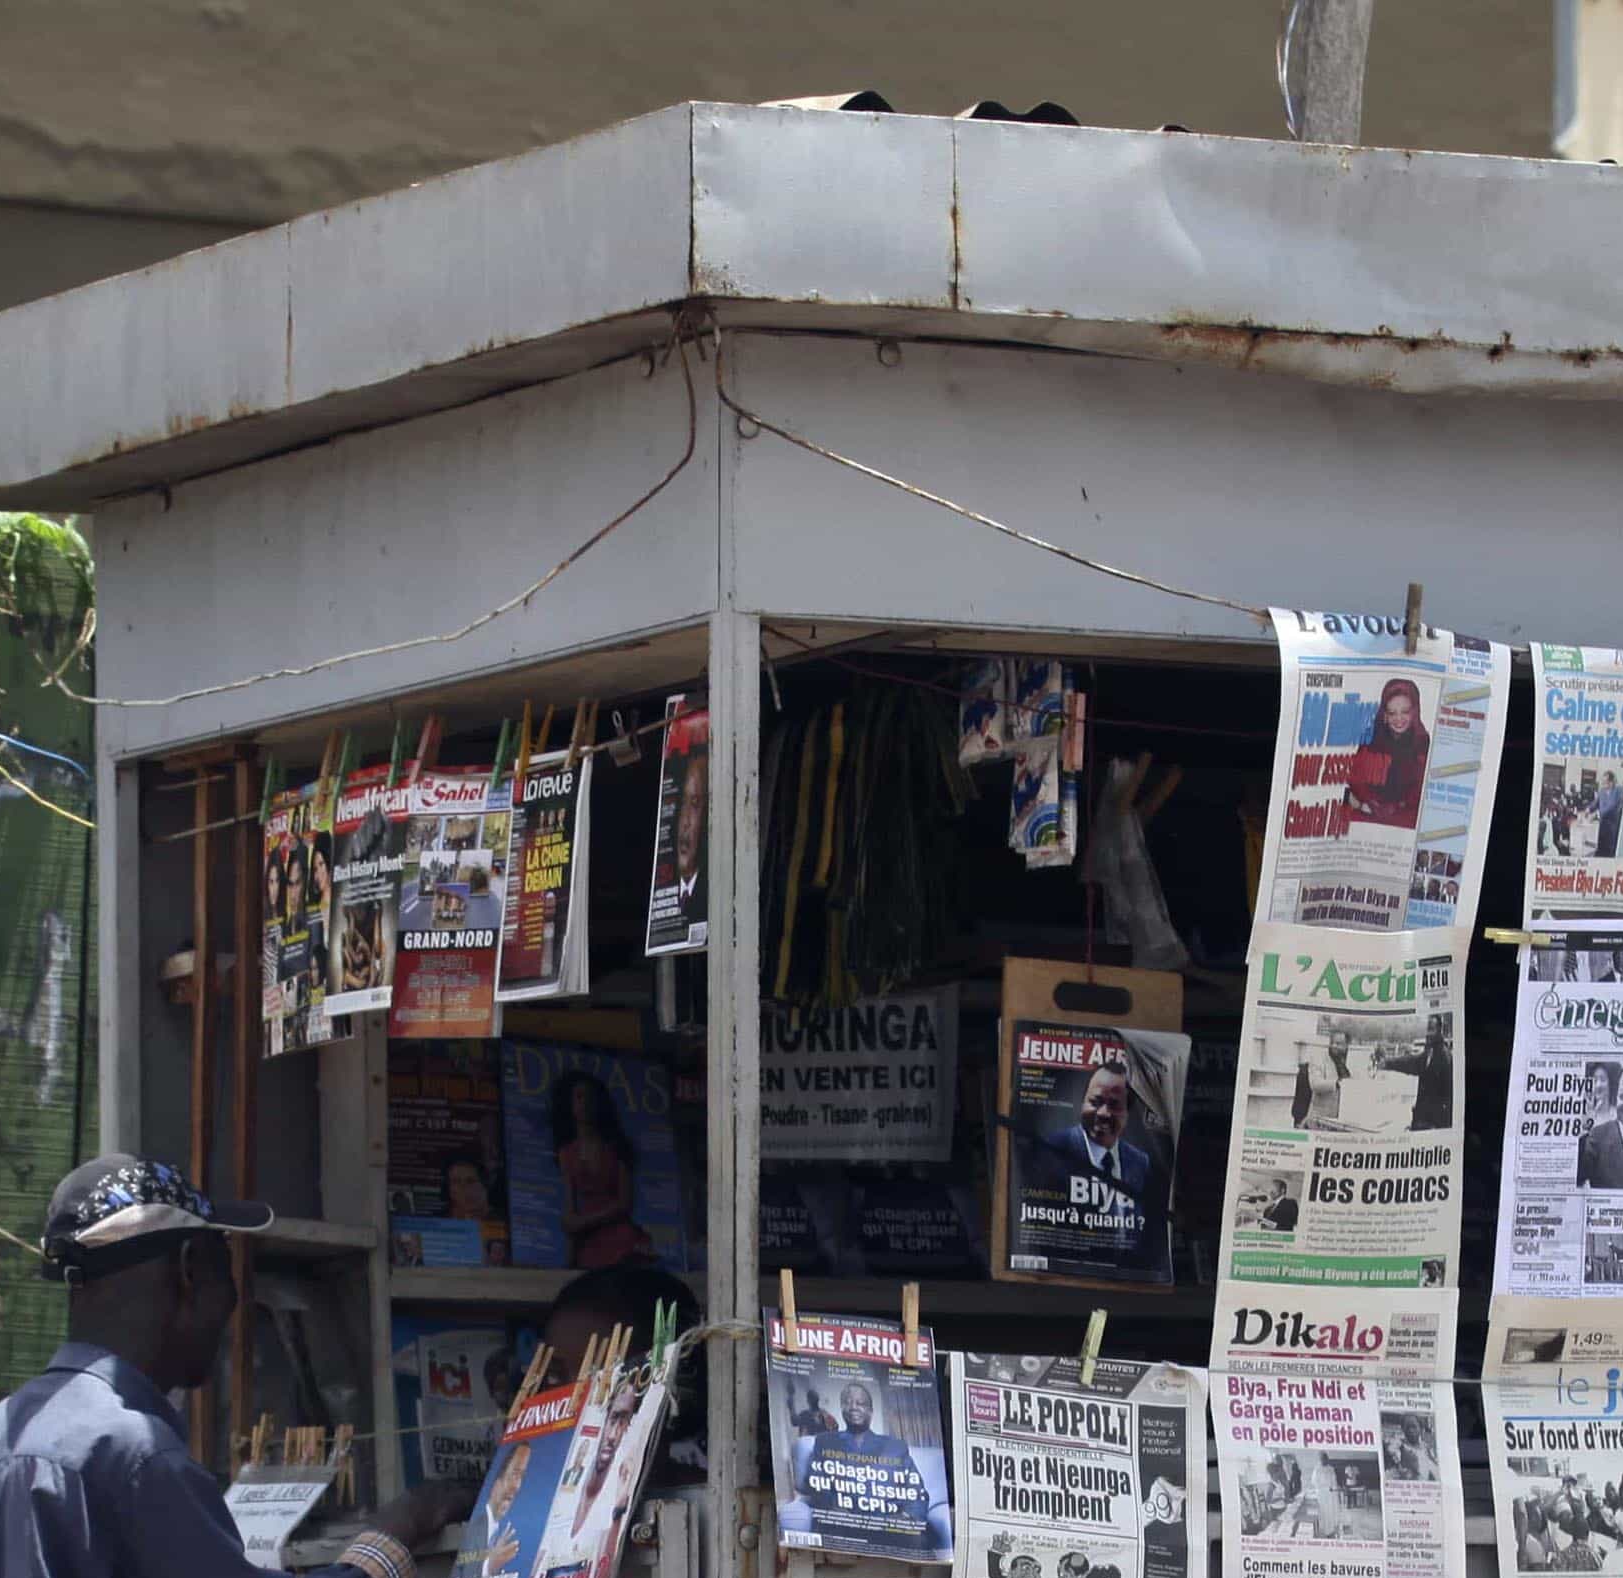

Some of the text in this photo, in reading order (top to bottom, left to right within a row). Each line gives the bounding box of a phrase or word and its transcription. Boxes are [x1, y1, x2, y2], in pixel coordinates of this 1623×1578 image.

[1546, 688, 1617, 724] Calme
[404, 930, 493, 949] GRAND-NORD
[1259, 952, 1417, 1003] L'Actu
[1421, 969, 1449, 991] Actu
[794, 1065, 935, 1090] VENTE ICI
[1526, 1074, 1594, 1099] Paul Biya
[1524, 1098, 1587, 1116] candidat
[1521, 1121, 1538, 1137] en
[1313, 1146, 1451, 1169] Elecam multiplie
[1309, 1172, 1449, 1205] les couacs
[1084, 1213, 1135, 1229] quand
[1230, 1308, 1383, 1351] Dikalo
[1571, 1332, 1603, 1347] 1,49
[840, 1329, 930, 1363] AFRIQE
[1227, 1376, 1365, 1400] Biya, Fru Ndi et
[1558, 1367, 1590, 1405] le
[1003, 1390, 1128, 1445] LE POPOLI
[1229, 1400, 1353, 1424] Garga Haman
[1232, 1426, 1375, 1448] en position
[1505, 1421, 1534, 1450] Sur
[1540, 1422, 1578, 1450] fond
[972, 1447, 1015, 1482] Biya
[1021, 1458, 1041, 1484] et
[1243, 1557, 1381, 1578] Comment les bavures
